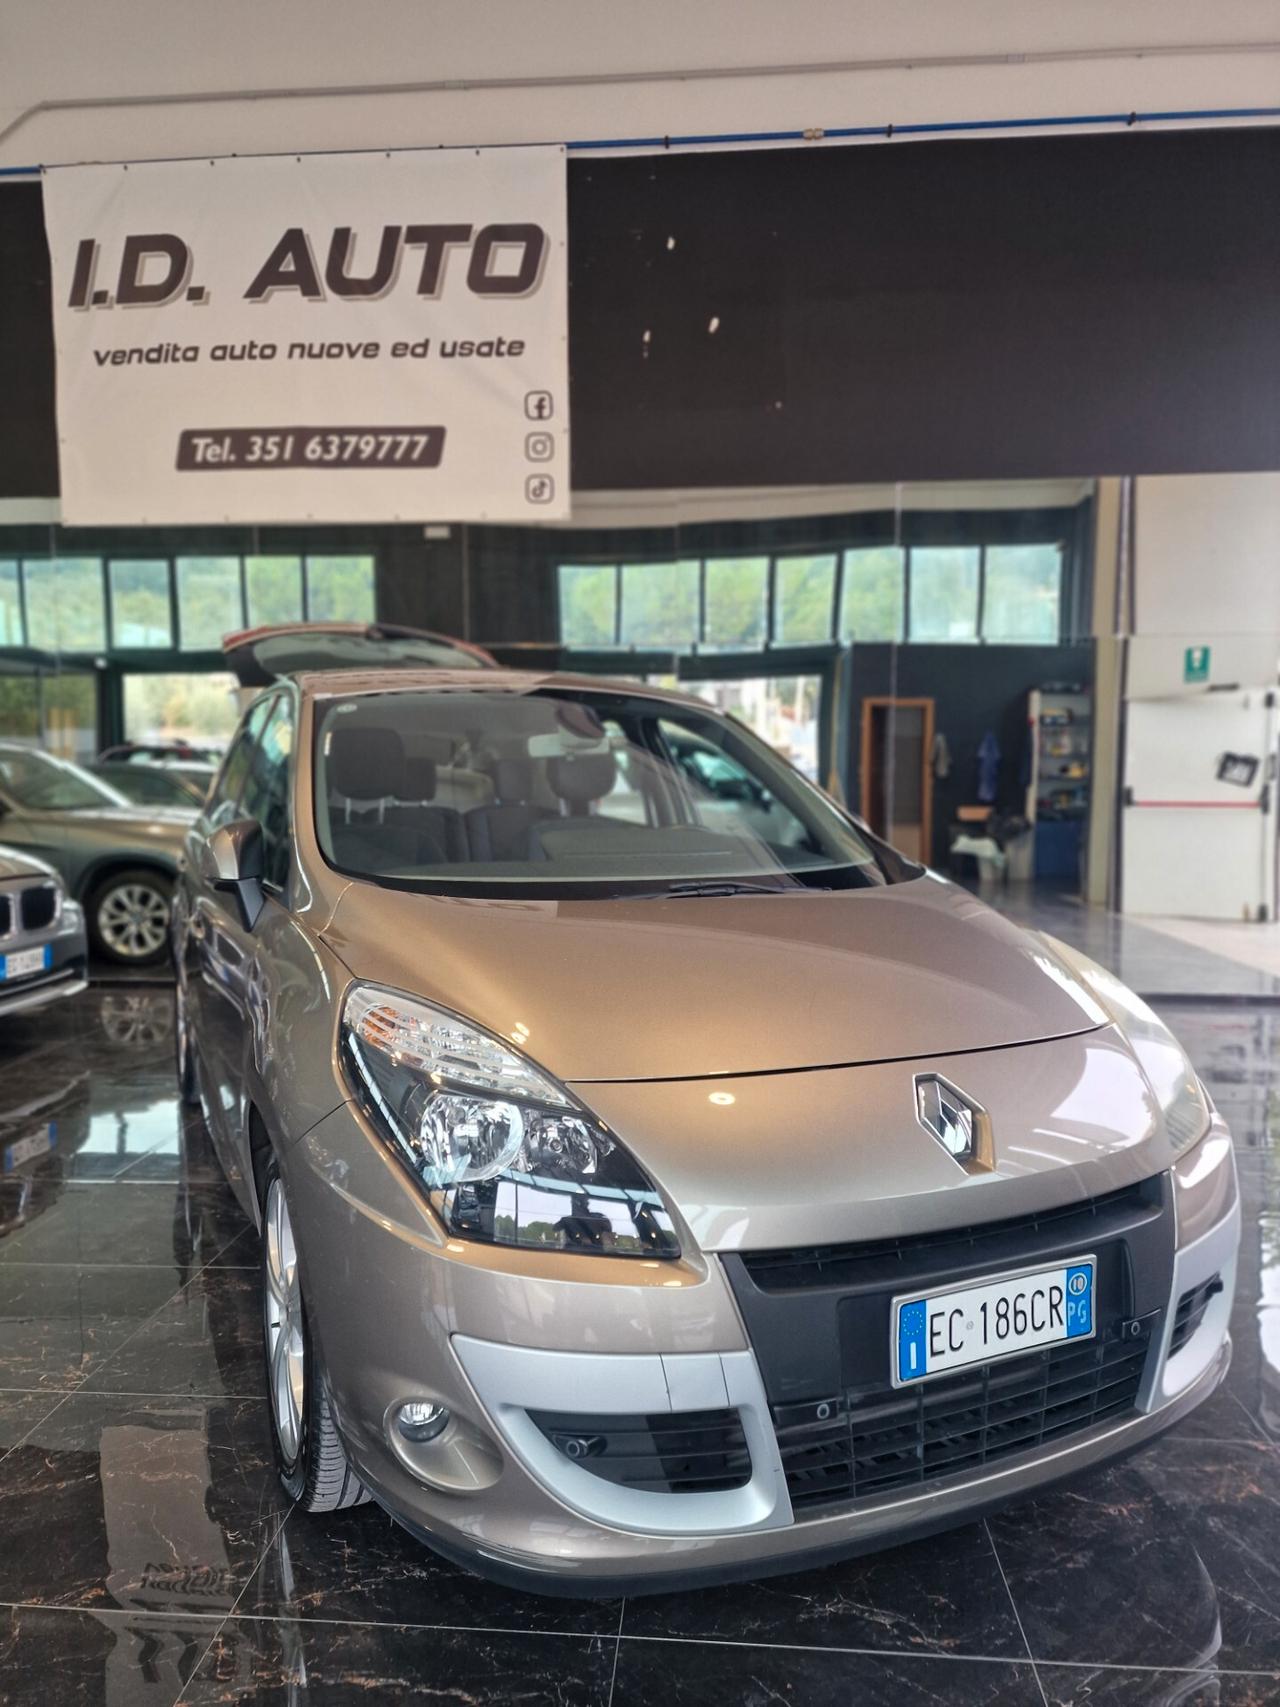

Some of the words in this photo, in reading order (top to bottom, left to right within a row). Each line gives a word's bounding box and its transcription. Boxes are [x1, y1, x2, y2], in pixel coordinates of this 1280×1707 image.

[68, 233, 209, 310] I.D.
[243, 223, 551, 303] AUTO
[93, 341, 199, 366] vendita
[210, 340, 277, 361] auto
[287, 340, 380, 360] nuove
[390, 338, 430, 358] ed
[439, 336, 525, 358] usate
[192, 437, 235, 462] Tel.
[245, 435, 295, 462] 351
[304, 435, 429, 461] 6379777
[1068, 1299, 1087, 1327] PG
